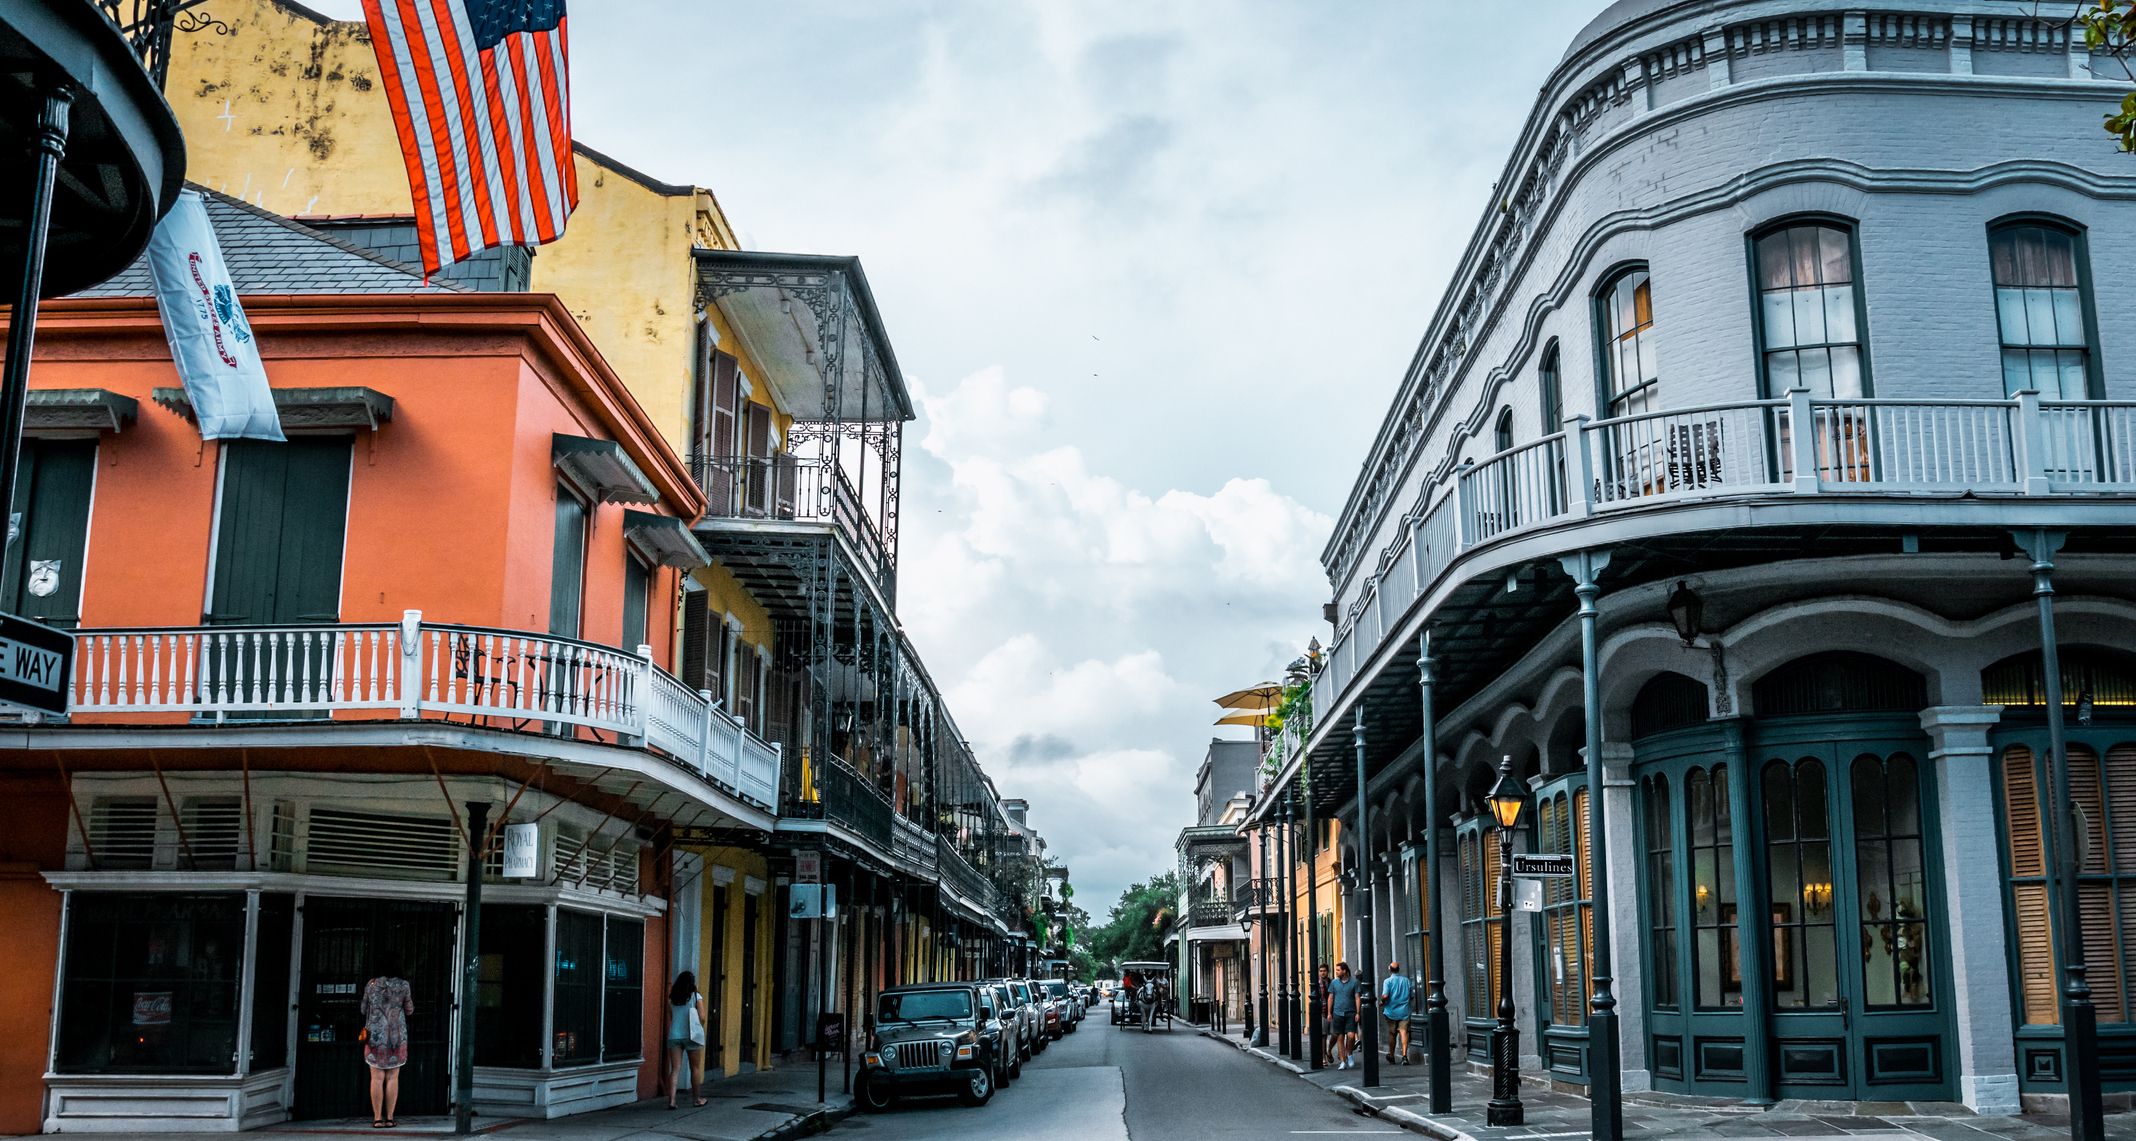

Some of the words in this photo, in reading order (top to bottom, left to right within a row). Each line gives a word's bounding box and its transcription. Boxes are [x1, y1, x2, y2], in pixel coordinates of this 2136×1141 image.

[190, 259, 207, 292] UNITED
[16, 646, 57, 685] WAY
[507, 828, 534, 856] ROYAL
[1515, 861, 1572, 872] Ursulines
